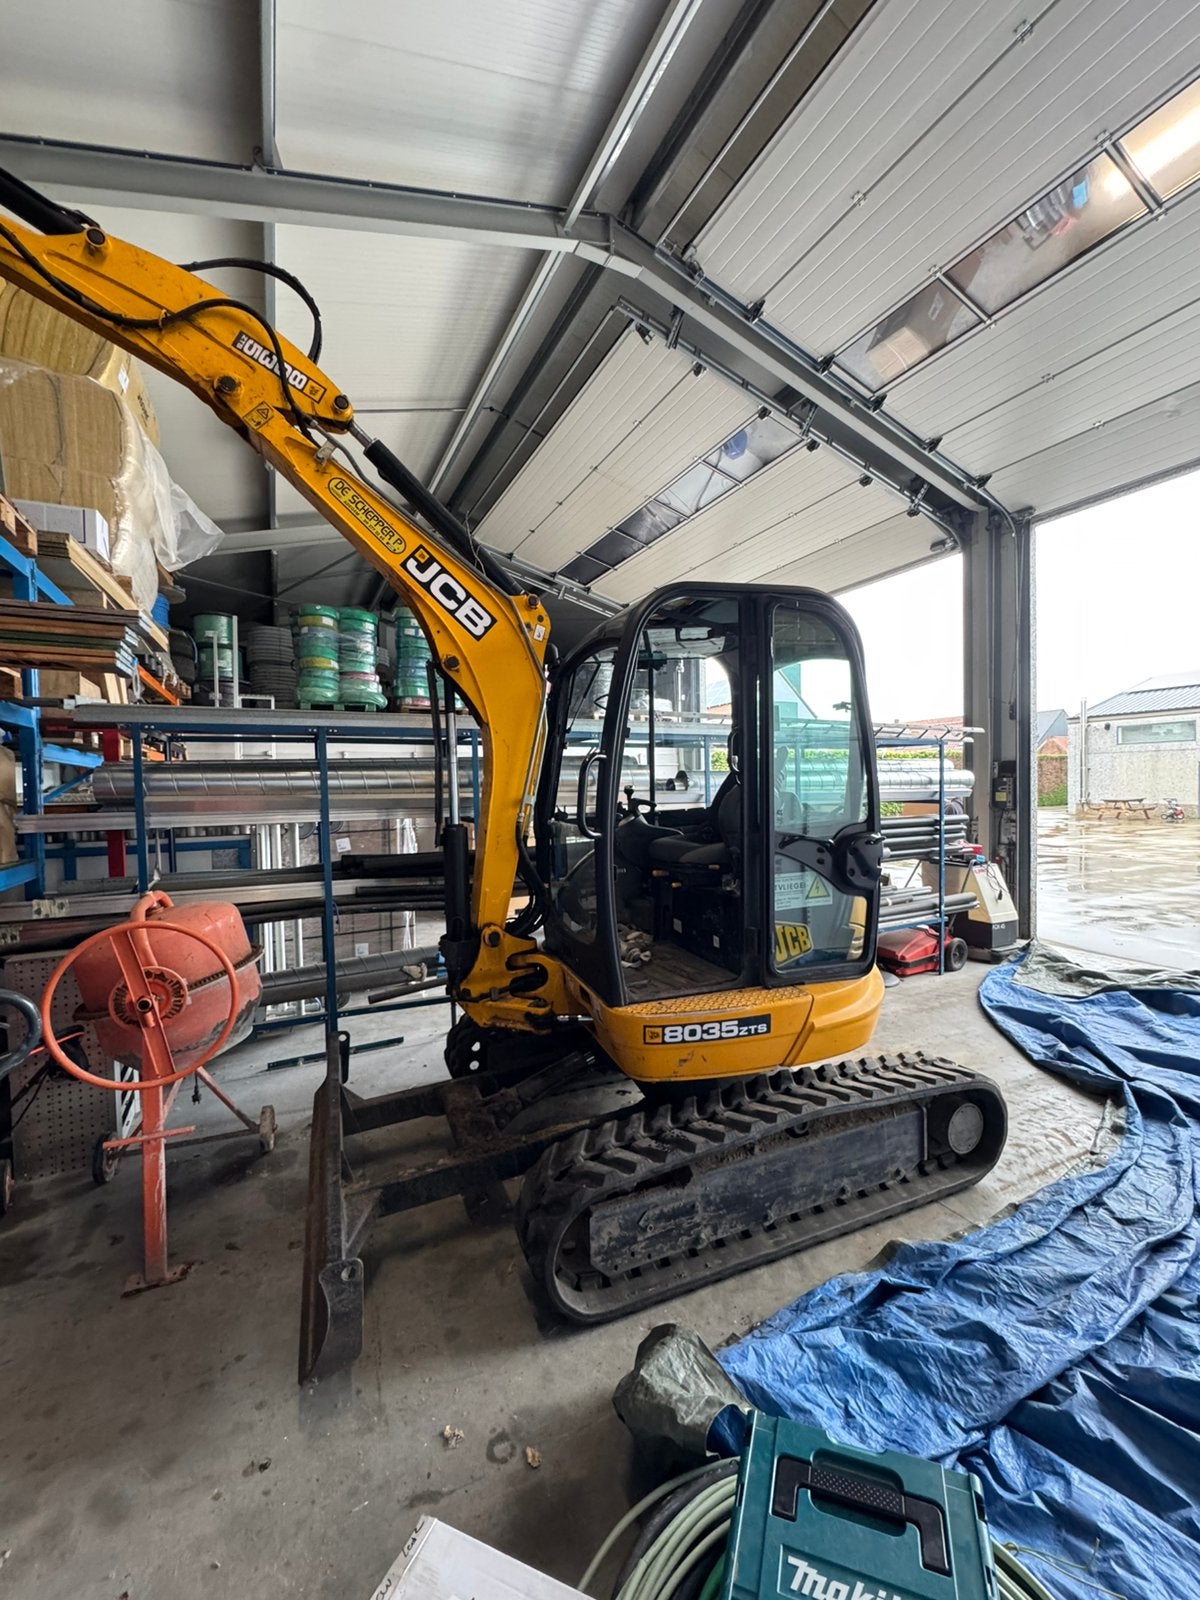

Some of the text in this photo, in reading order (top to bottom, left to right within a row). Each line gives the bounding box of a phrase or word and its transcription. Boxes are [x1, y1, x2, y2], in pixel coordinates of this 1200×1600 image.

[334, 480, 351, 496] DE
[348, 494, 395, 541] SCHEPPER
[392, 538, 403, 546] P
[406, 557, 492, 636] JCB
[775, 924, 811, 962] JCB
